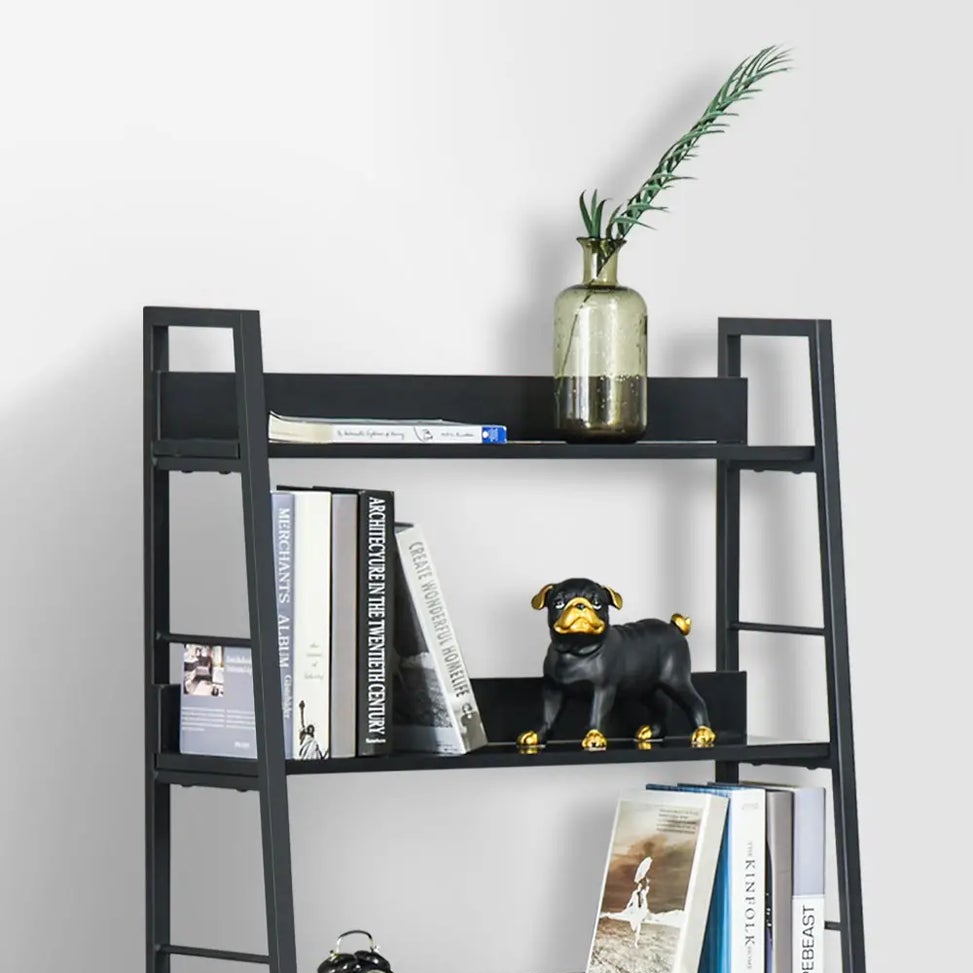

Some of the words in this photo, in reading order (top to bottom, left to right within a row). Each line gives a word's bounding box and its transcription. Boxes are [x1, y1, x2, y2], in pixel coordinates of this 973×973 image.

[278, 507, 291, 604] MERCHANTS
[368, 582, 385, 595] IN
[368, 597, 386, 619] THE
[278, 614, 291, 668] ALBUM
[408, 541, 433, 580] CREATE
[421, 579, 454, 646] WONDERFUL
[442, 644, 470, 697] HOMELIFE
[367, 619, 386, 682] TWENTIETH
[367, 683, 386, 735] CENTURY
[745, 859, 757, 946] KINFOLK
